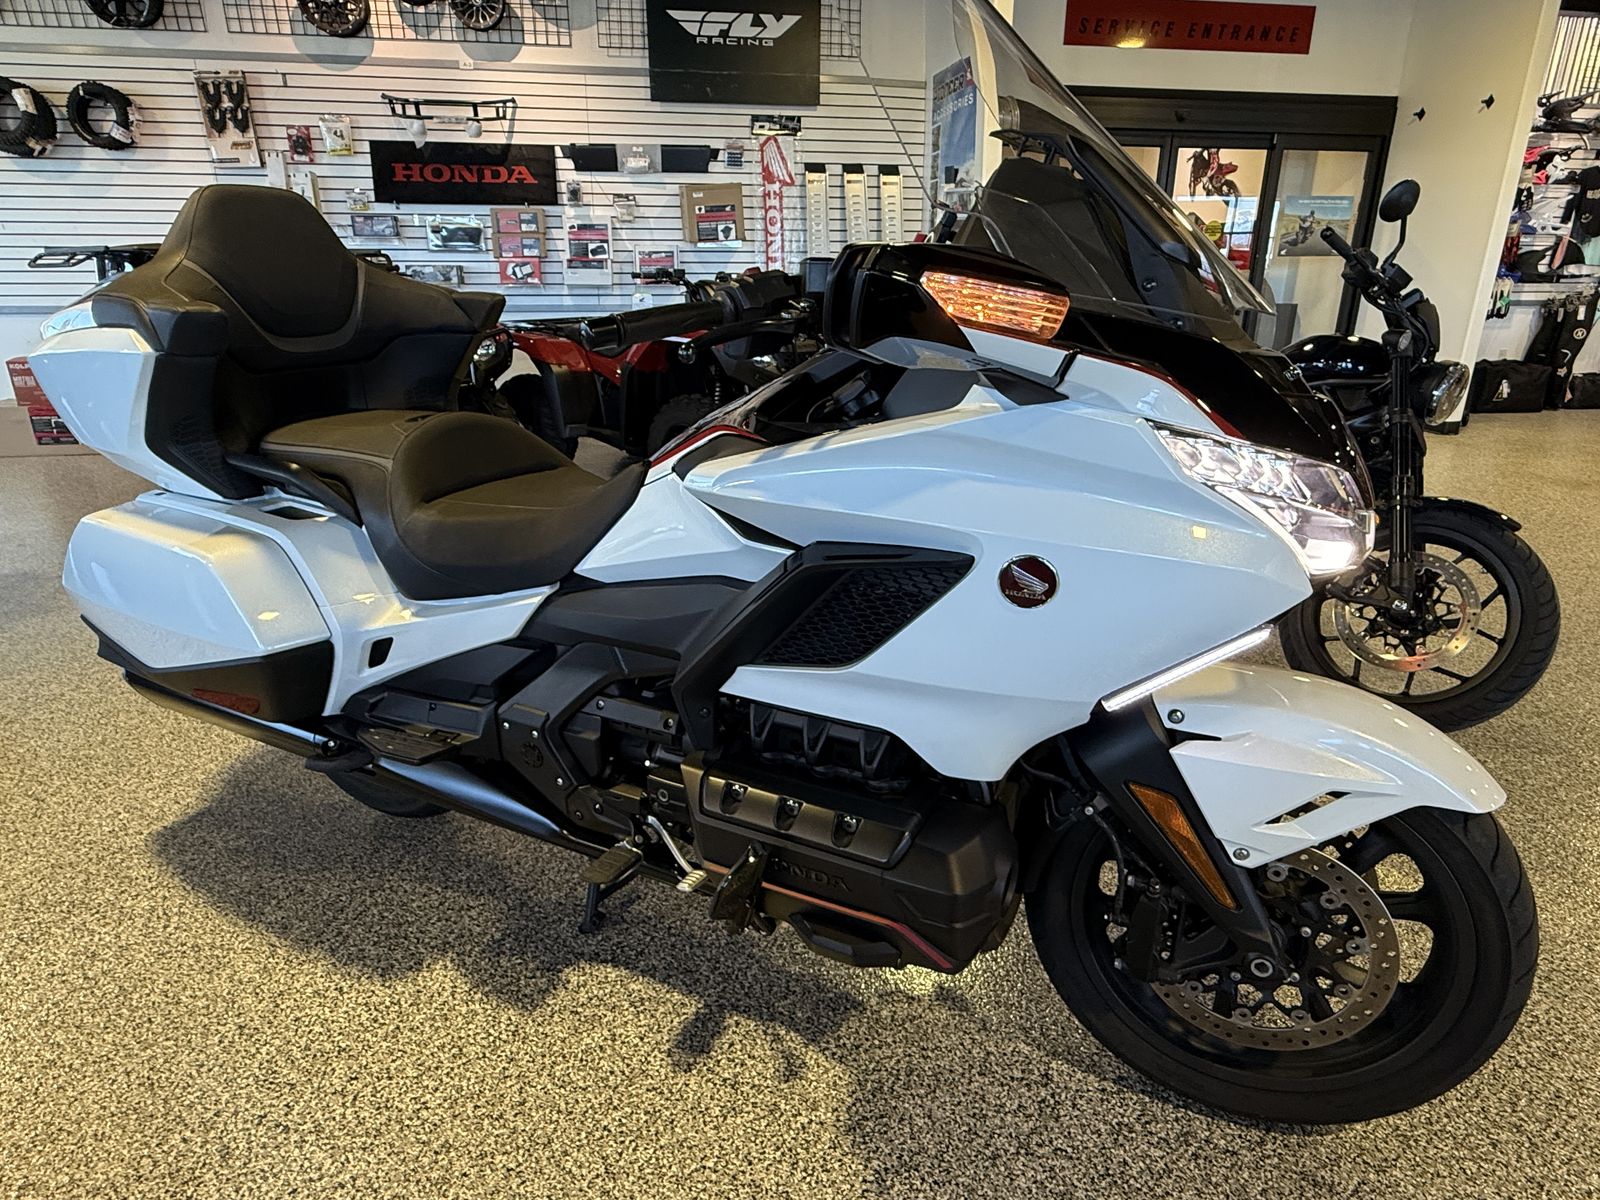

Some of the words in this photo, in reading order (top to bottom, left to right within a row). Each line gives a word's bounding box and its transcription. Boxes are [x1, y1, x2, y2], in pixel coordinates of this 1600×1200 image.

[665, 9, 802, 38] FLY
[1078, 16, 1177, 38] SERVICE
[1186, 22, 1300, 43] ENTRANCE
[695, 36, 774, 47] RACING
[390, 162, 539, 184] HONDA
[764, 181, 783, 271] HON
[1004, 588, 1047, 601] HONDA
